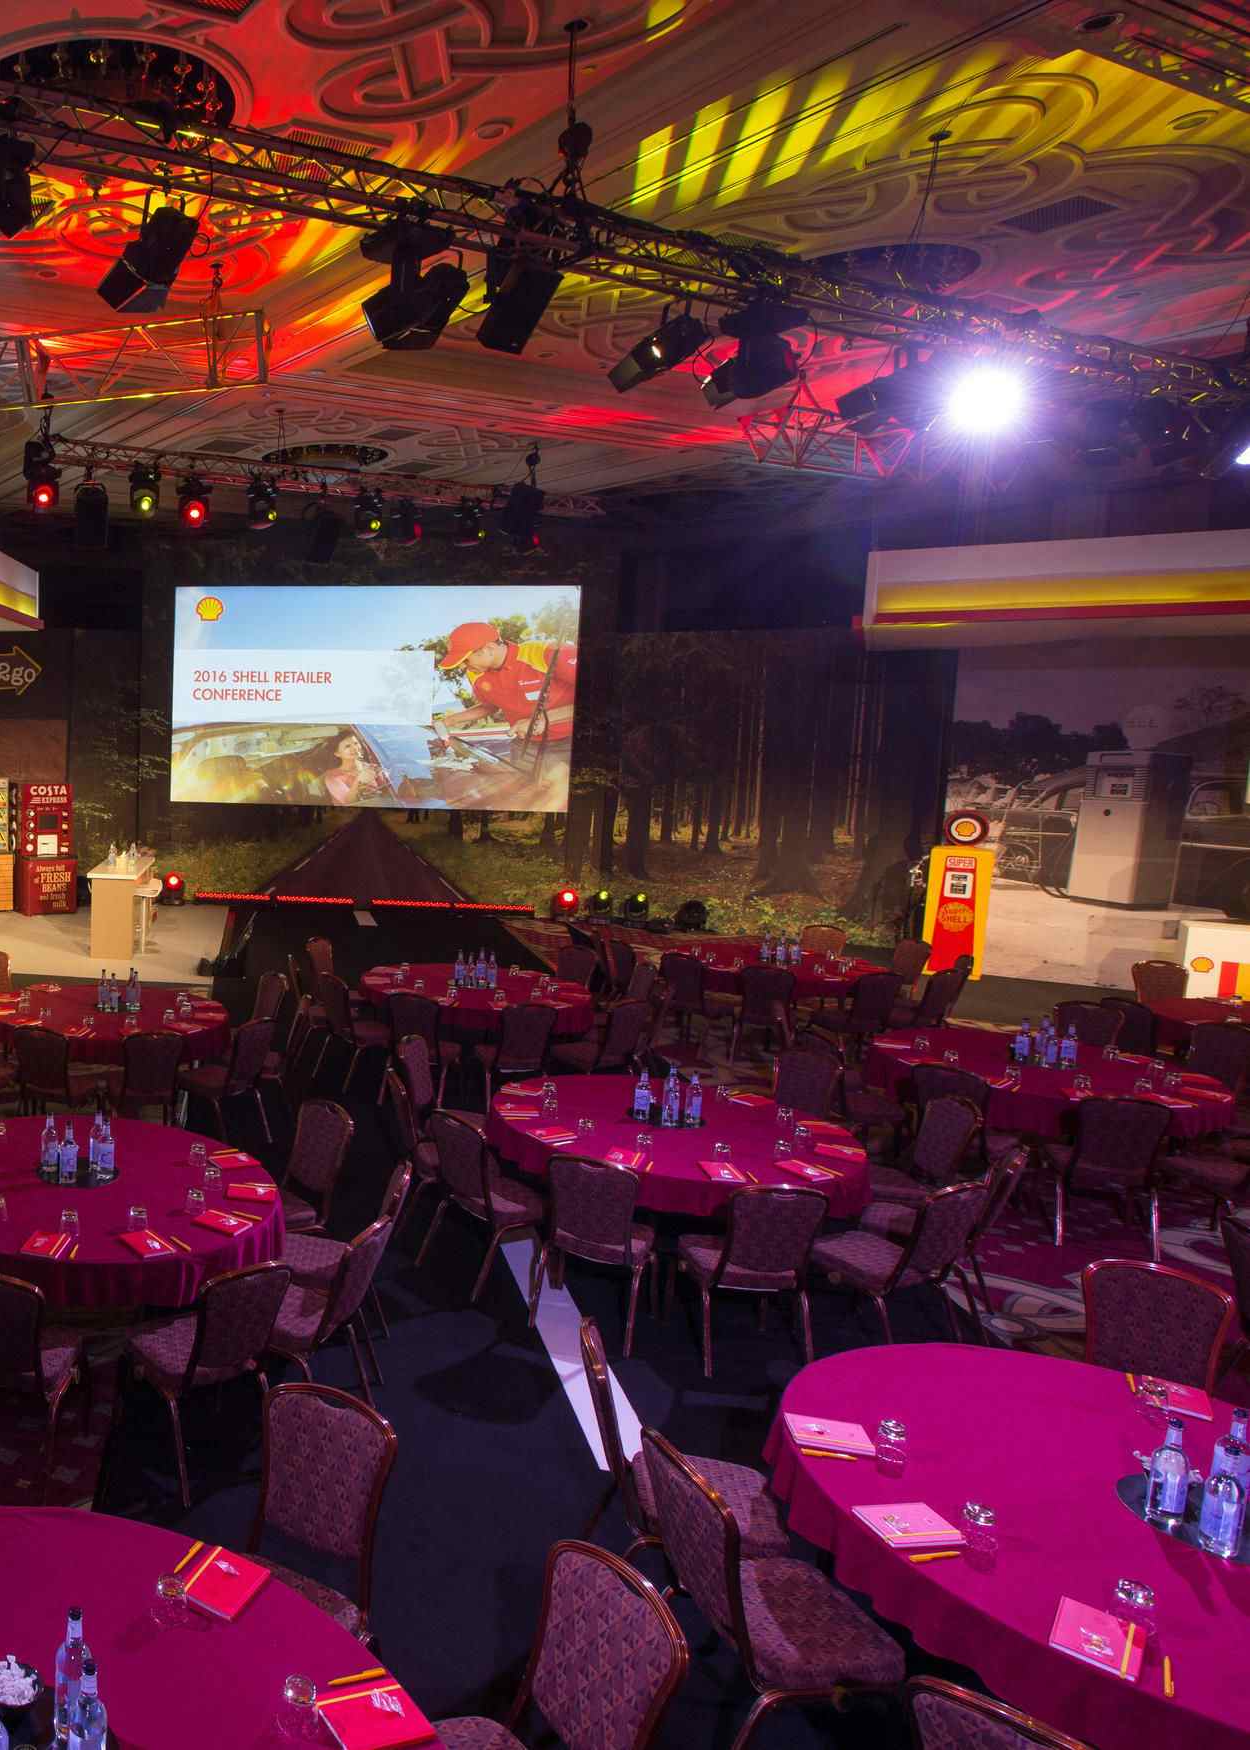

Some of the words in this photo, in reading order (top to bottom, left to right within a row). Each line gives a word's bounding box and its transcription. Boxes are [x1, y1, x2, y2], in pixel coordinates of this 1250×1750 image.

[193, 670, 227, 684] 2016
[232, 670, 270, 684] SHELL
[274, 670, 332, 684] RETAILER
[192, 687, 282, 702] CONFERENCE
[30, 785, 68, 796] COSTA
[40, 871, 71, 884] FRESH
[42, 883, 68, 893] BEANS
